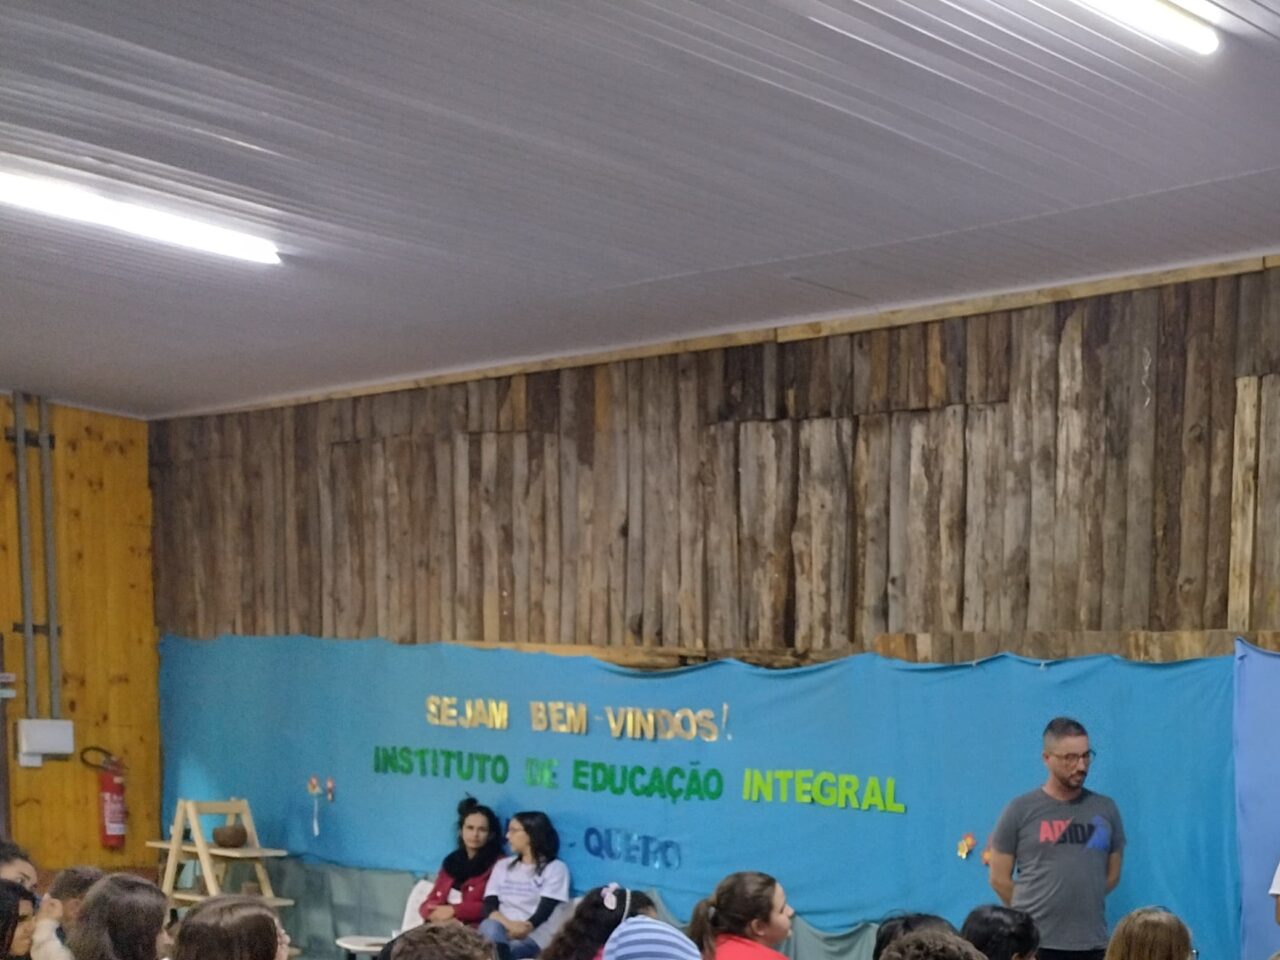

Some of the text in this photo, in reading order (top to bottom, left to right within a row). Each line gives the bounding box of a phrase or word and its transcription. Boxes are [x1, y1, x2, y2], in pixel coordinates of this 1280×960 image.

[426, 695, 509, 730] SEJAM
[373, 746, 905, 813] INSTITUTO DE EDUCAÇÃO INTEGRAL
